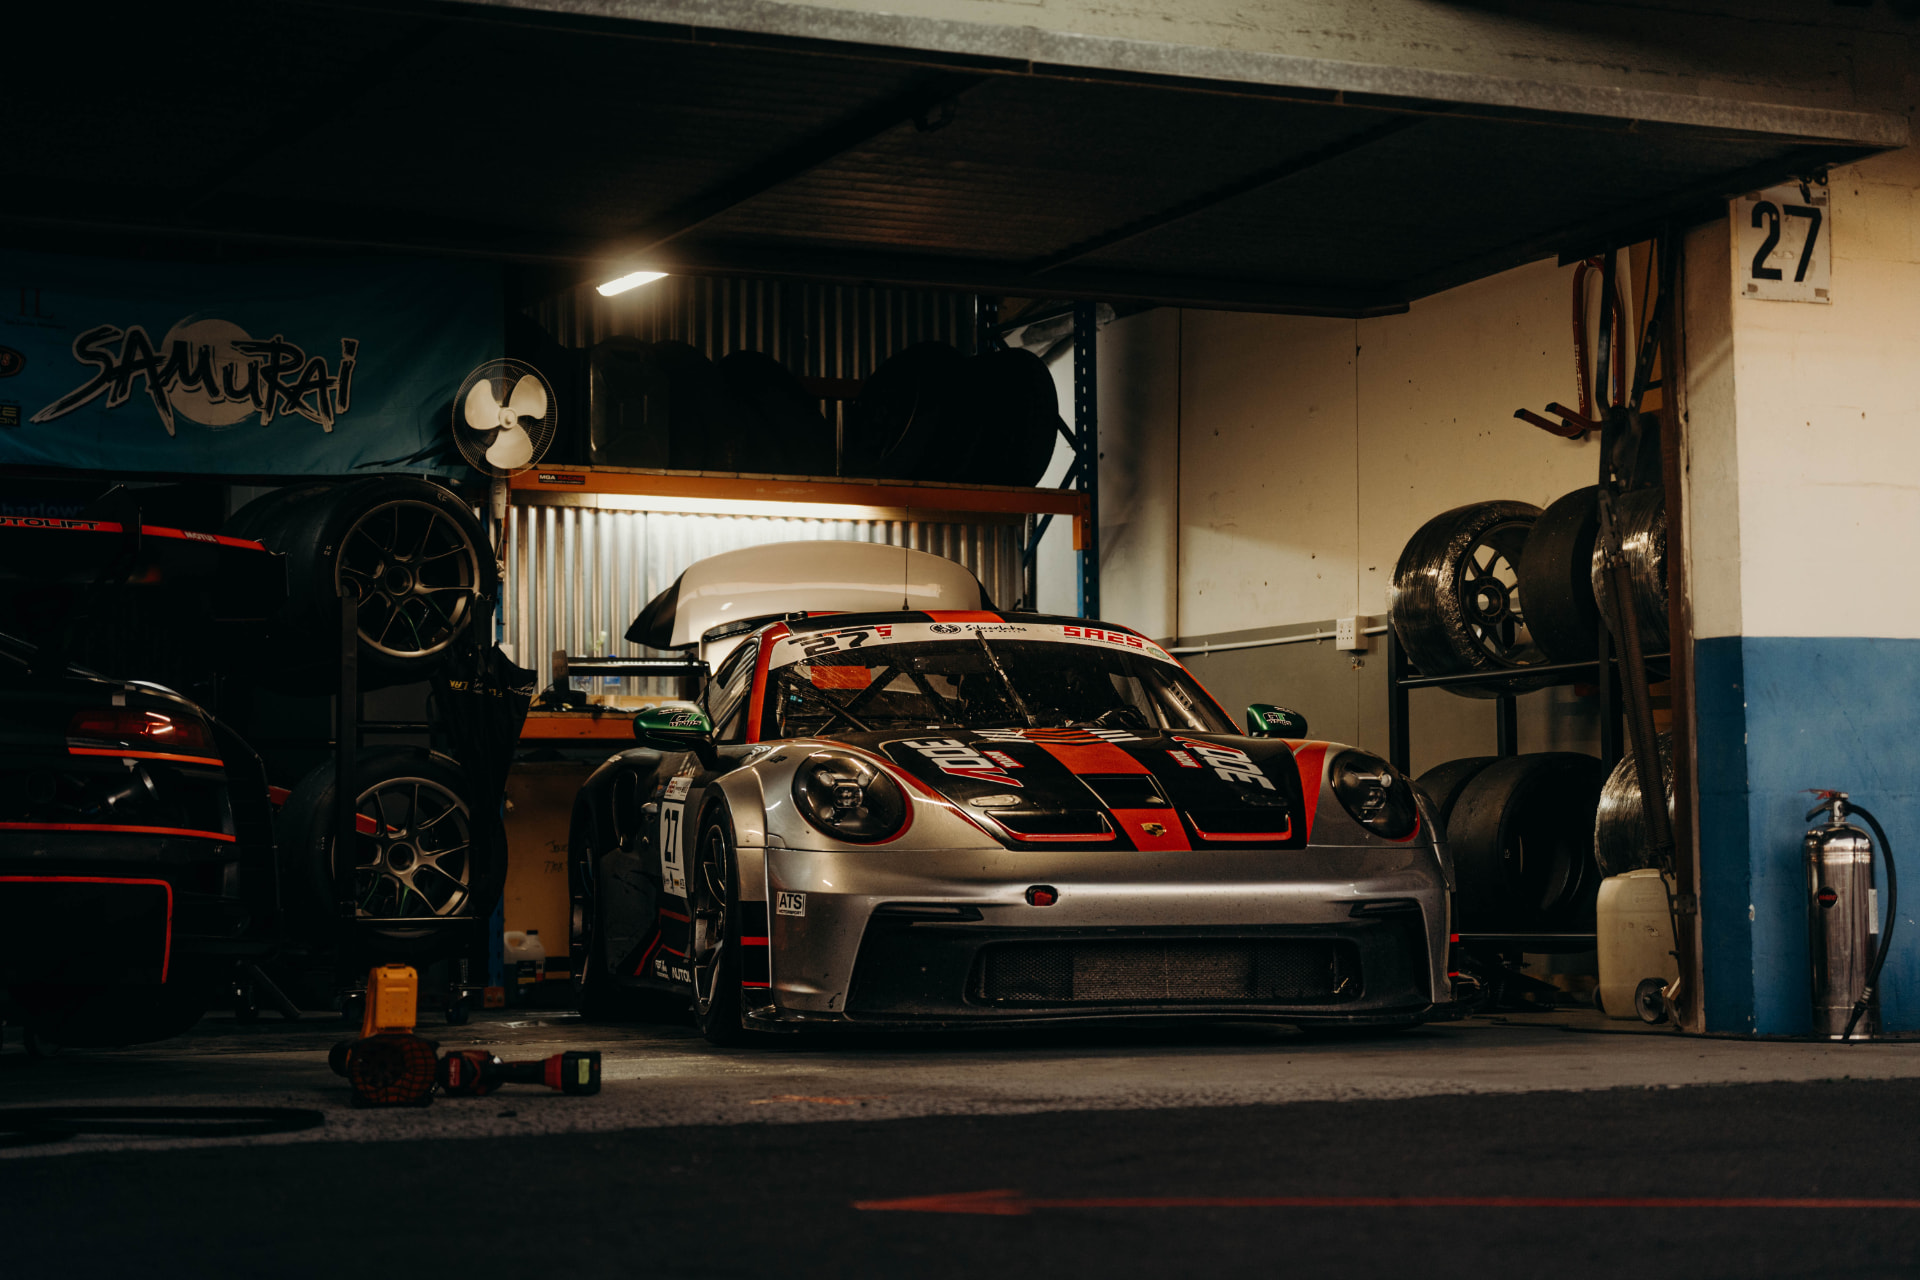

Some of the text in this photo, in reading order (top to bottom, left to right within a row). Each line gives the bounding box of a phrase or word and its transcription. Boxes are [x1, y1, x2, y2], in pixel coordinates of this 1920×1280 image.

[1752, 201, 1822, 282] 27
[800, 631, 870, 657] 27
[664, 807, 680, 863] 27
[779, 893, 803, 910] ATS
